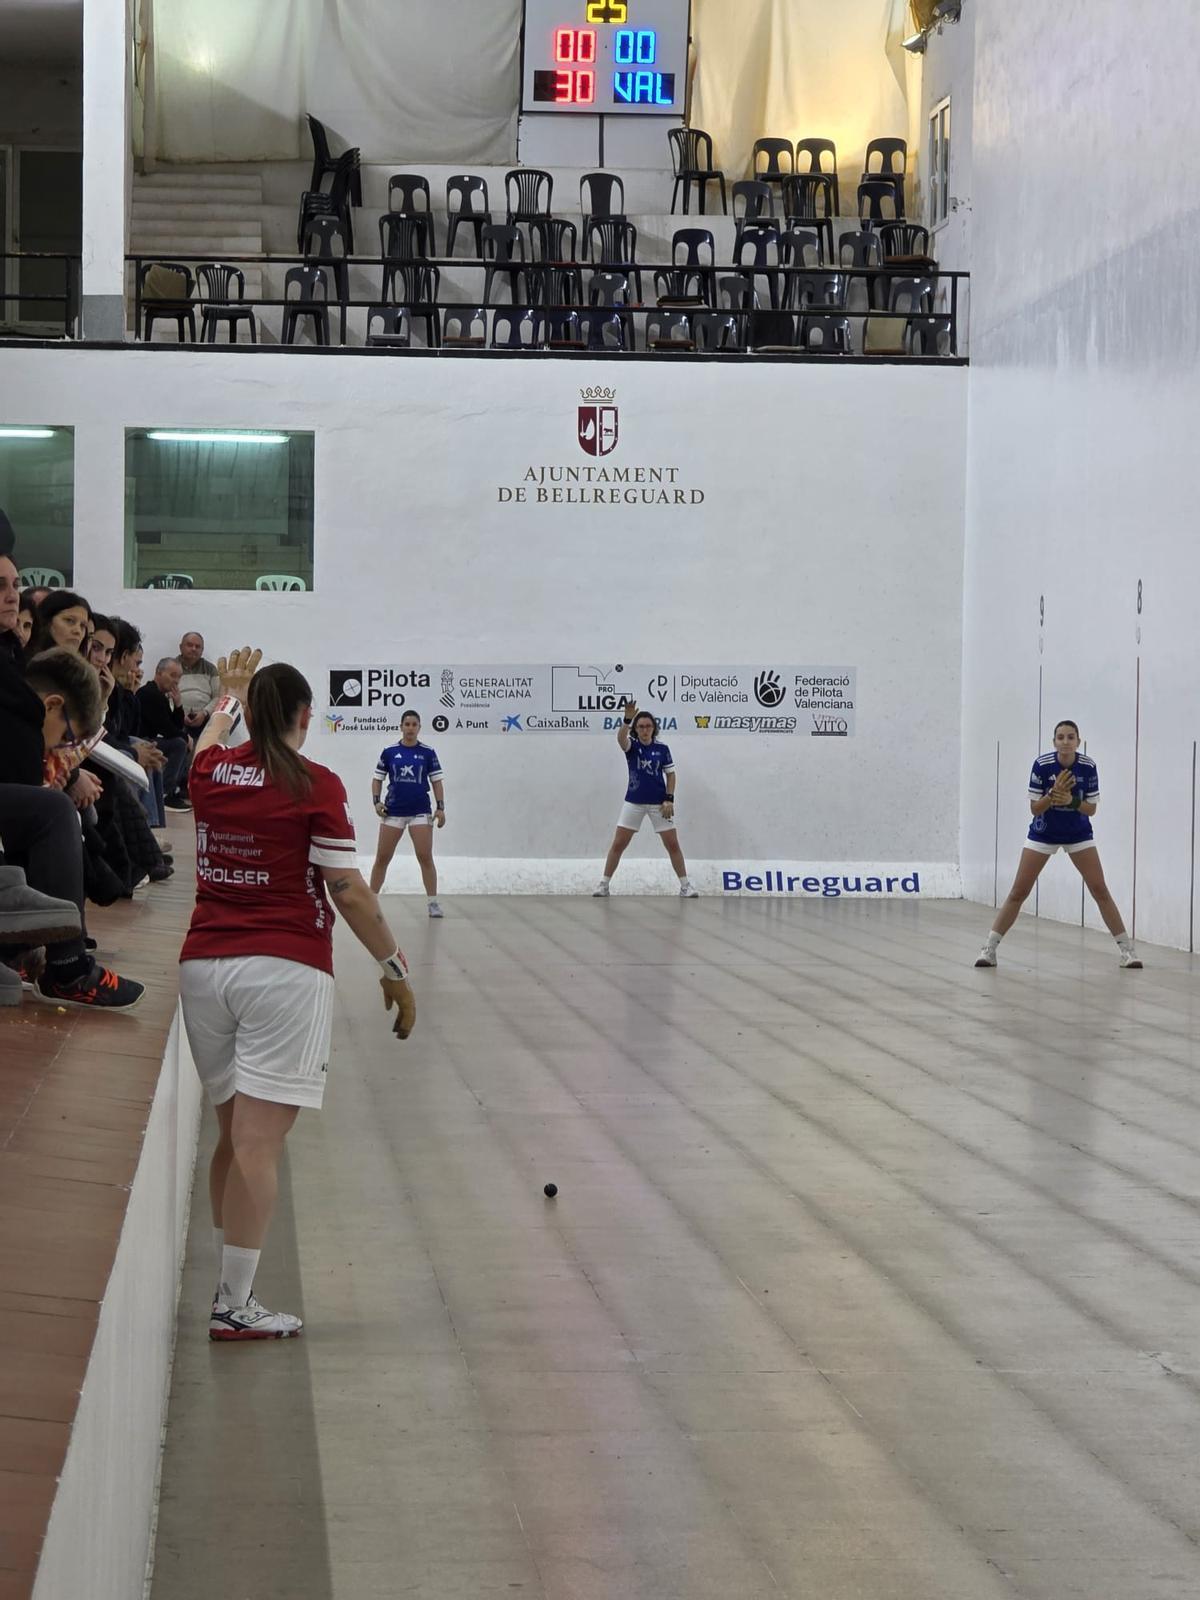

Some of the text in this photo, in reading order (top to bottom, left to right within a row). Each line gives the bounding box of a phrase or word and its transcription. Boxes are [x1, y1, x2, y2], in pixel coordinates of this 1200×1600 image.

[556, 29, 595, 62] 00
[616, 31, 655, 63] 00
[556, 70, 594, 102] 30
[614, 72, 672, 104] VAL
[524, 466, 679, 485] AJUNTAMENT
[497, 487, 705, 504] DE BELLREGUARD
[1137, 578, 1143, 615] 8
[368, 669, 430, 687] Pilota
[459, 678, 534, 687] GENERALITAT
[681, 675, 738, 689] Diputació
[795, 675, 850, 686] Federació
[368, 689, 405, 707] Pro
[460, 689, 532, 698] VALENCIANA
[680, 691, 748, 703] de València
[794, 687, 843, 697] de Pilota
[578, 695, 628, 710] LLIGA
[794, 698, 853, 709] Valenciana
[353, 716, 387, 724] Fundació
[455, 717, 489, 728] À Punt
[526, 715, 590, 728] CaixaBank
[604, 717, 678, 730] BARIA
[714, 716, 797, 732] masymas
[814, 719, 848, 732] VITO
[377, 724, 399, 732] López
[212, 762, 265, 787] MIREIA
[210, 831, 255, 843] Ajuntament
[208, 844, 263, 857] de Pedreguer
[203, 867, 270, 885] ROLSER
[722, 871, 921, 897] Bellreguard
